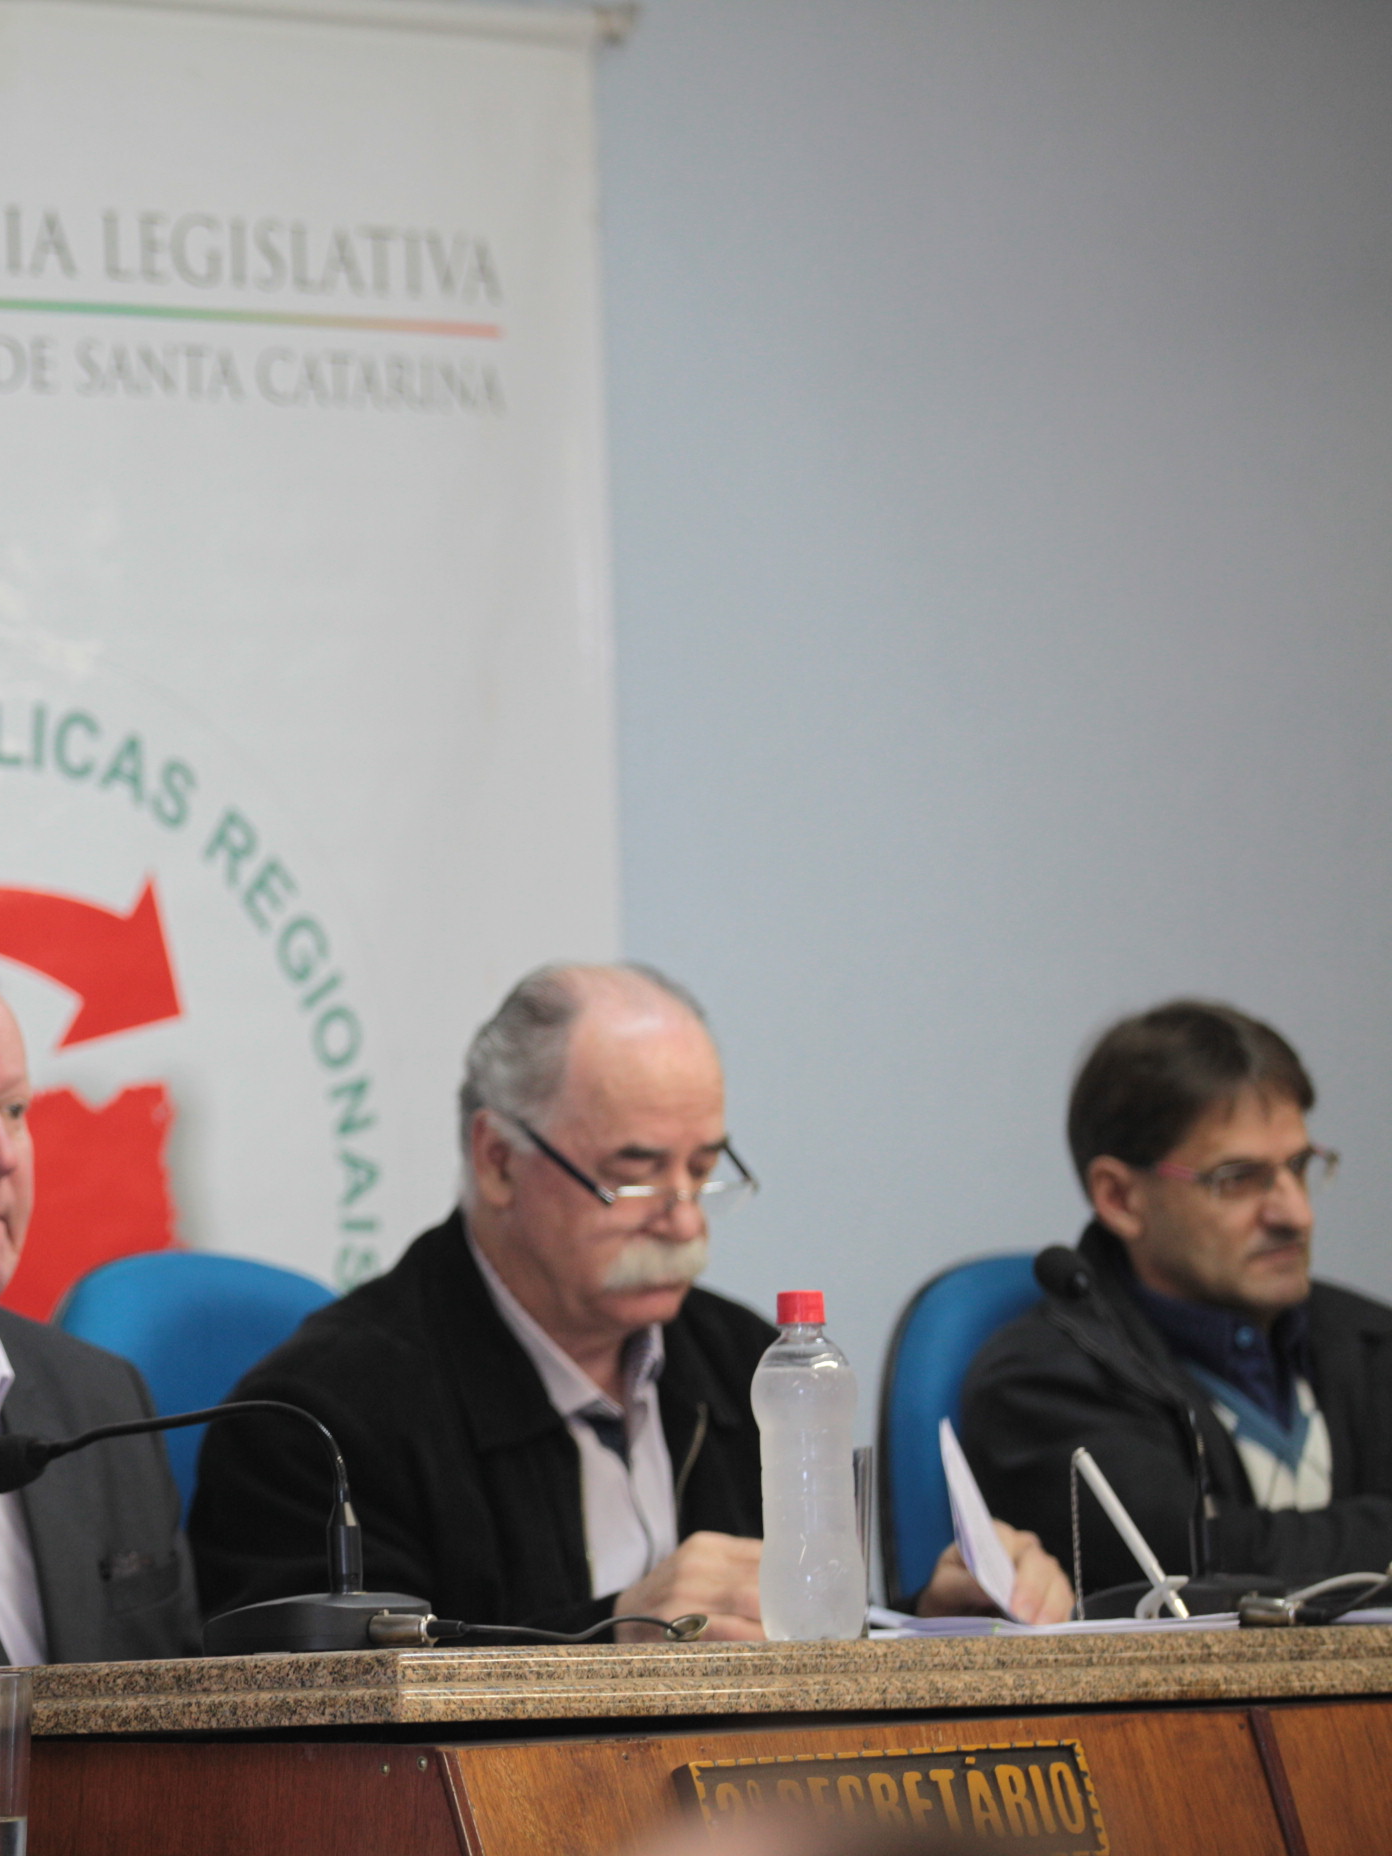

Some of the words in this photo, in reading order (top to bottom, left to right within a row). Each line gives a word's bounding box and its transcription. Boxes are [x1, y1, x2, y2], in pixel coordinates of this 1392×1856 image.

[101, 207, 504, 306] LEGISLATIVA
[74, 337, 247, 402] SANTA
[254, 345, 507, 416] CATARINA
[204, 806, 381, 1293] REGIONAIS
